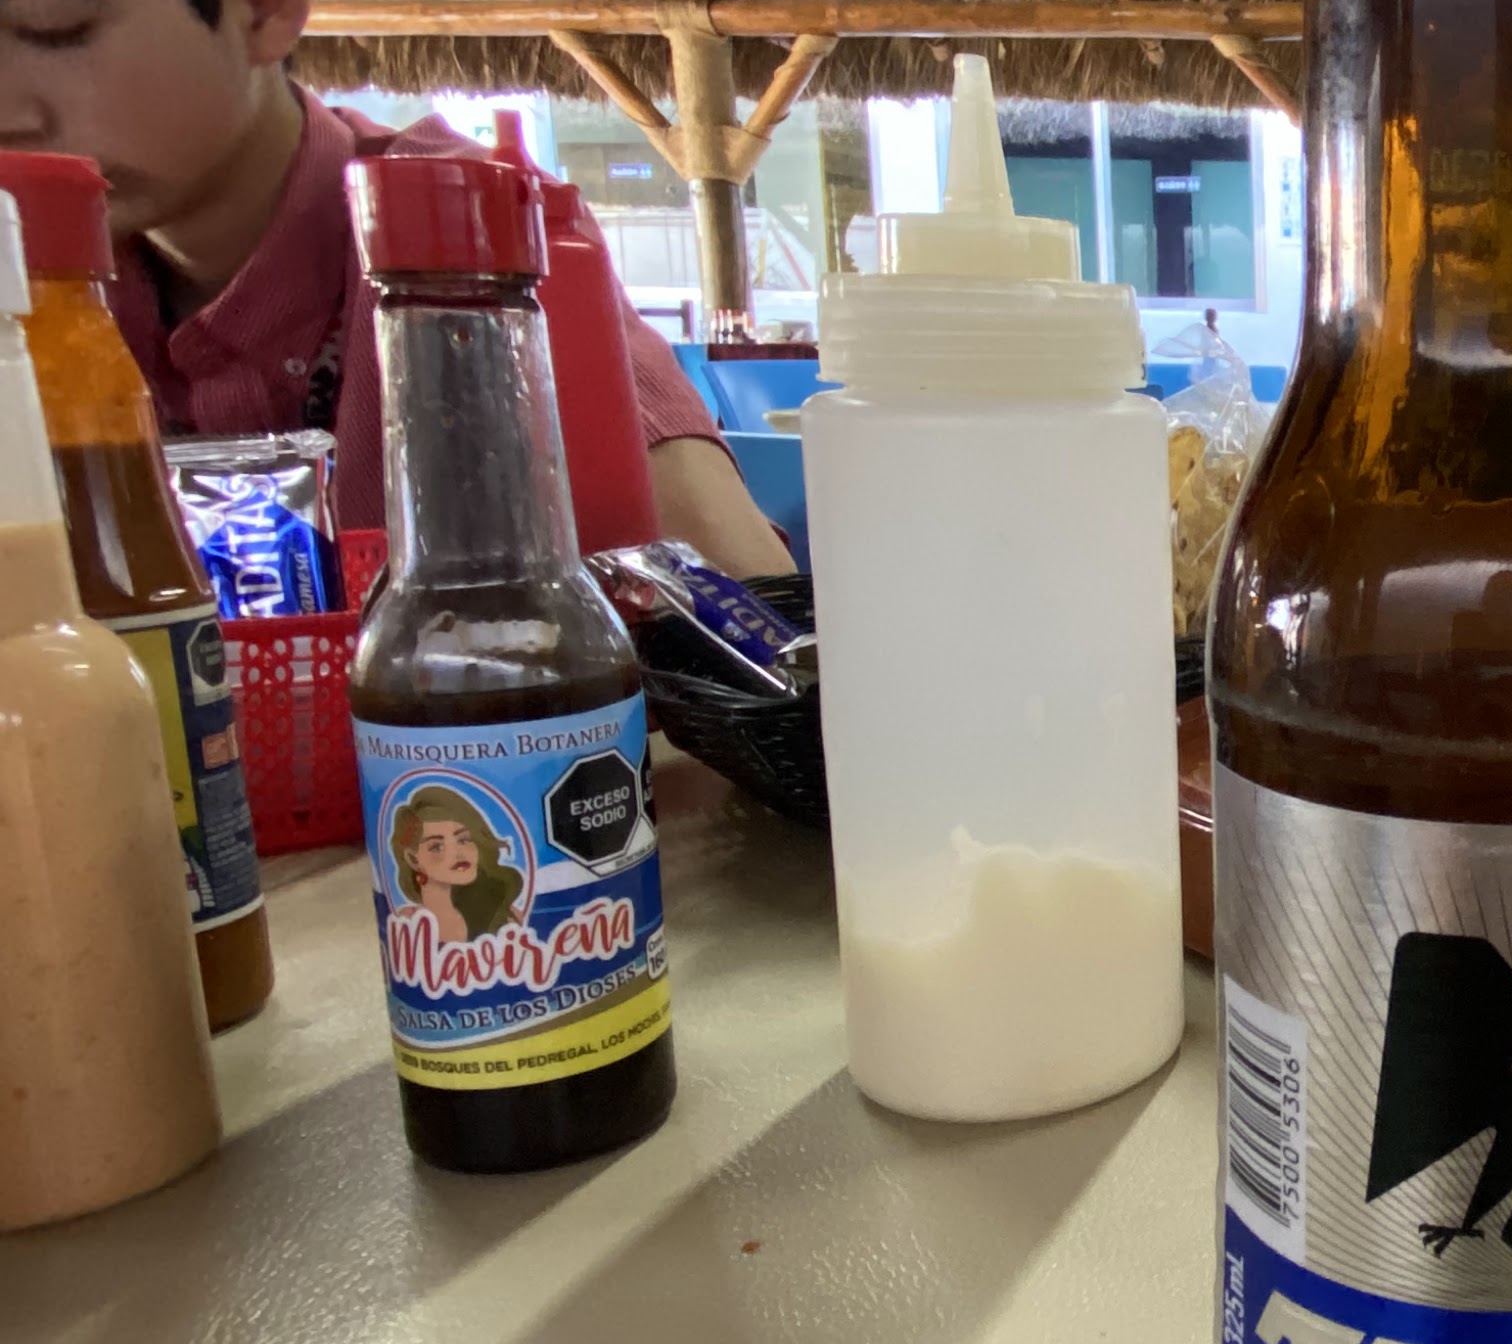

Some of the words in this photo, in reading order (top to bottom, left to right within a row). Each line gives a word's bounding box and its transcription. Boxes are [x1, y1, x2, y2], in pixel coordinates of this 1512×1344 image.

[570, 786, 630, 816] EXCESO
[580, 805, 626, 831] SODIO
[459, 1010, 492, 1029] DE
[500, 999, 547, 1024] LOS
[420, 1058, 480, 1074] BOSQUES
[484, 1060, 512, 1073] DEL
[601, 1031, 625, 1049] LOS
[1283, 1058, 1300, 1133] 5306
[1283, 1146, 1300, 1220] 7500
